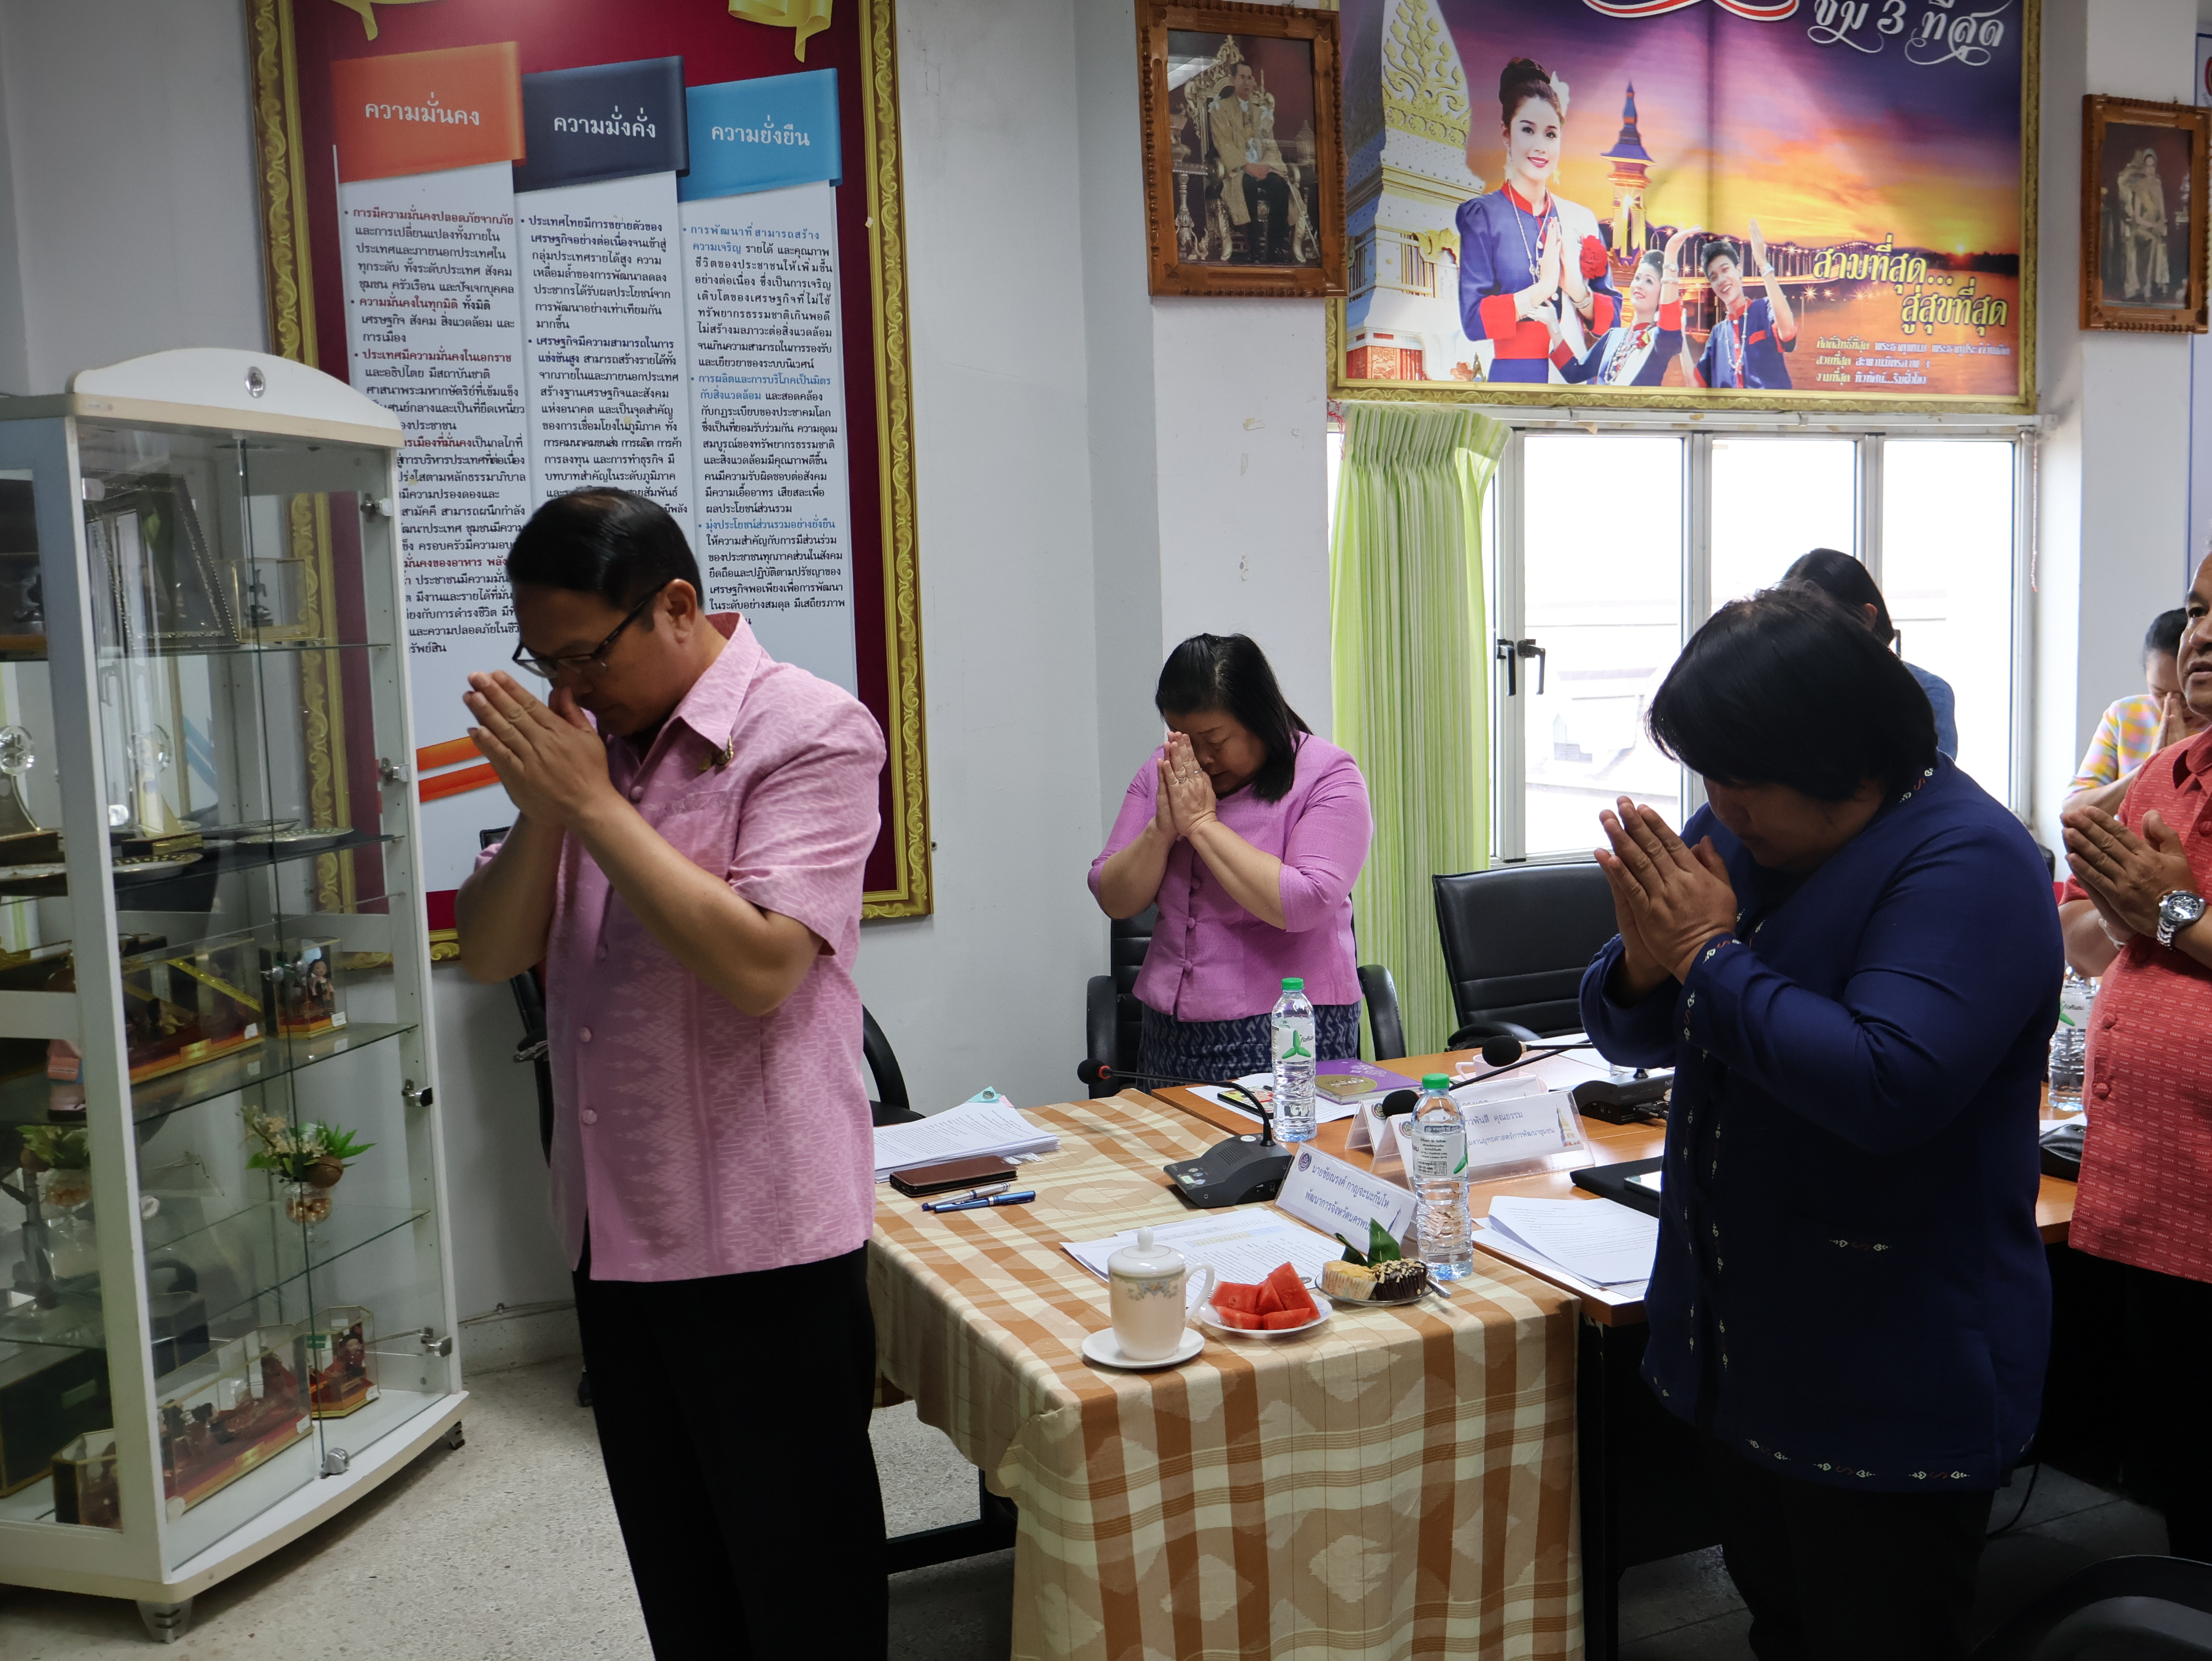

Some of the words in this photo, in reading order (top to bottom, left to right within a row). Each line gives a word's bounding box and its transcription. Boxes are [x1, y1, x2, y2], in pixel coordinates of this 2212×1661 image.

[1877, 0, 1906, 34] 3
[365, 92, 480, 125] ความมั่นคง
[554, 105, 656, 138] ความมั่งคั่ง
[712, 115, 810, 146] ความยั่งยืน
[353, 204, 514, 225] การมีความมั่นคงปลอดภัยจากภัย
[355, 222, 500, 241] และการเปลี่ยนแปลงทั้งภายใน
[356, 243, 506, 259] ประเทศและภายนอกประเทศใน
[693, 241, 741, 255] ความเจริญ
[746, 242, 773, 254] รายได้
[777, 247, 830, 259] และคุณภาพ
[532, 249, 631, 267] กลุ่มประเทศรายได้สูง
[485, 265, 511, 277] สังคม
[359, 280, 388, 293] ชุมชน
[392, 279, 435, 291] ครัวเรือน
[695, 271, 755, 287] อย่างต่อเนื่อง
[1901, 278, 2008, 337] สู่สุขที่สุด
[362, 314, 405, 328] เศรษฐกิจ
[410, 314, 436, 326] สังคม
[441, 311, 492, 328] สิ่งแวดล้อม
[497, 319, 515, 328] และ
[536, 314, 570, 329] มากขึ้น
[363, 331, 406, 343] การเมือง
[536, 335, 674, 349] เศรษฐกิจมีความสามารถในการ
[362, 345, 511, 362] ประเทศมีความมั่นคงในเอกราช
[539, 368, 679, 382] จากภายในและภายนอกประเทศ
[540, 385, 669, 400] สร้างฐานเศรษฐกิจและสังคม
[700, 385, 761, 400] กับสิ่งแวดล้อม
[766, 390, 823, 401] และสอดคล้อง
[541, 402, 594, 414] แห่งอนาคต
[401, 419, 456, 430] องประชาชน
[665, 415, 677, 431] ทั้ง
[797, 425, 837, 437] ความอุดม
[404, 433, 523, 448] ารเมืองที่มั่นคงเป็นกลไกที่
[622, 437, 654, 448] การผลิต
[657, 436, 682, 448] การค้า
[397, 450, 525, 468] สู่การบริหารประเทศที่ต่อเนื่อง
[545, 455, 589, 468] การลงทุน
[668, 453, 675, 464] มี
[705, 470, 827, 481] คนมีความรับผิดชอบต่อสังคม
[705, 483, 773, 497] มีความเอื้ออาทร
[778, 483, 825, 497] เสียสละเพื่อ
[401, 505, 436, 516] สามัคคี
[706, 501, 792, 513] ผลประโยชน์ส่วนรวม
[404, 553, 482, 568] มั่นคงของอาหาร
[708, 549, 843, 564] ของประชาชนทุกภาคส่วนในสังคม
[710, 598, 790, 612] ในระดับอย่างสมดุล
[409, 642, 447, 654] รัพย์สิน
[1493, 1111, 1523, 1124] คุณธรรม
[1312, 1165, 1348, 1187] นายชัยณรงค์
[1304, 1188, 1370, 1232] พัฒนาการจังหวัดนครพน
